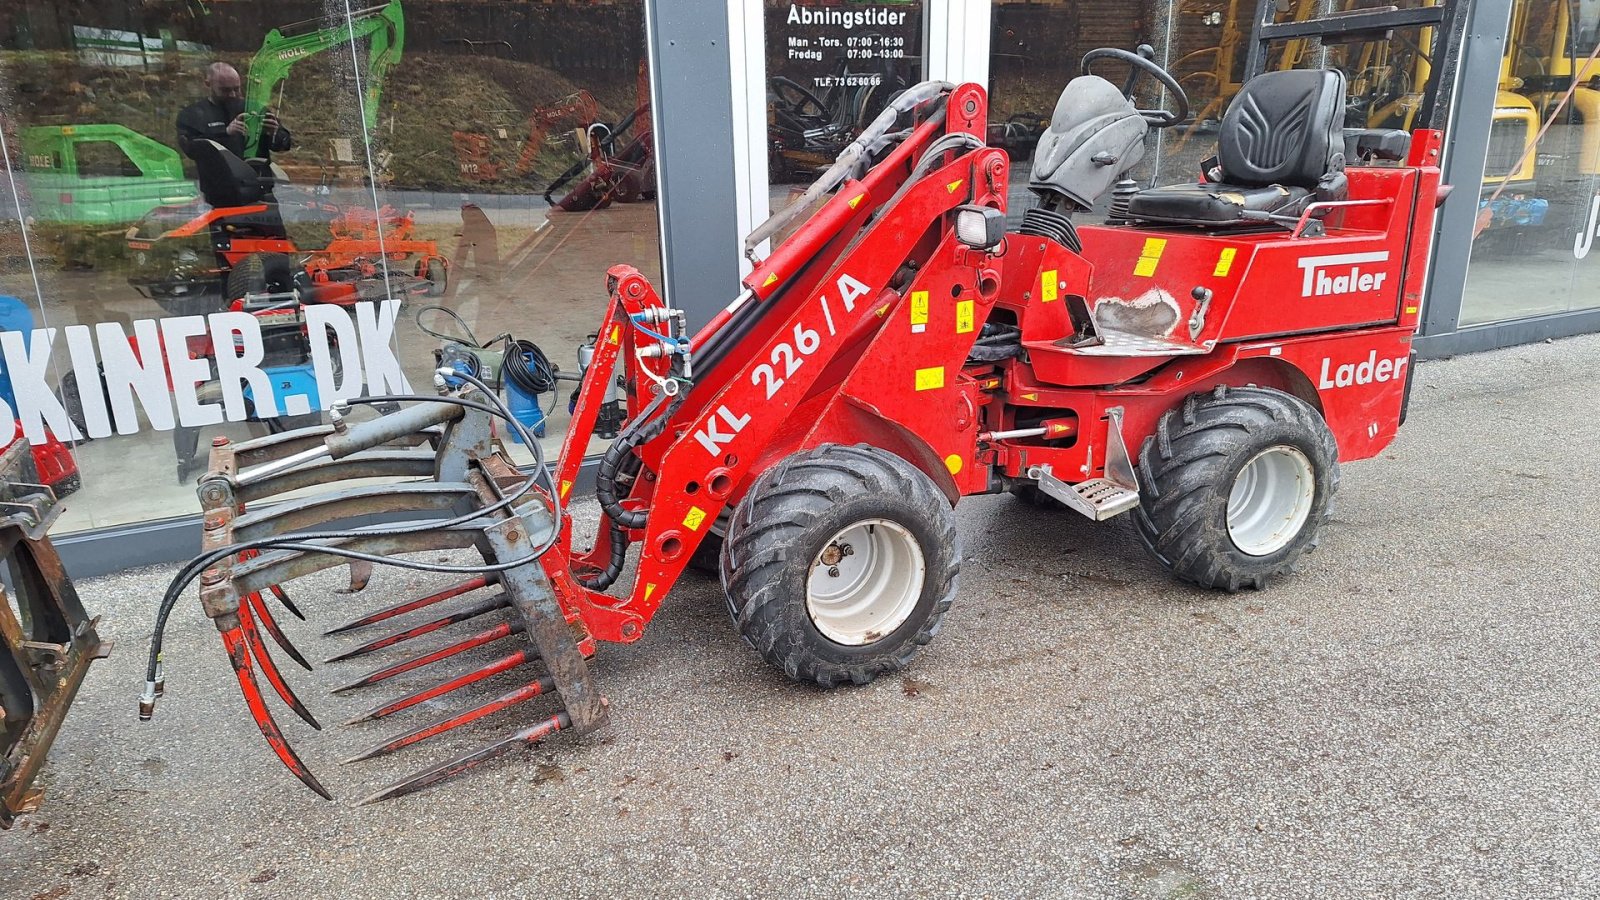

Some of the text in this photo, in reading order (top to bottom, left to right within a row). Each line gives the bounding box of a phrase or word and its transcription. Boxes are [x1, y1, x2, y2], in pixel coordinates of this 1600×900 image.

[787, 4, 906, 29] Åbningstider
[788, 37, 808, 47] Man
[818, 37, 843, 47] Tors.
[788, 49, 822, 61] Fredag
[814, 77, 833, 87] TLF.
[461, 163, 478, 174] M12
[1297, 250, 1390, 297] Thaler
[0, 299, 415, 447] KINER.DK
[1319, 350, 1408, 390] Lader
[693, 404, 752, 457] KL
